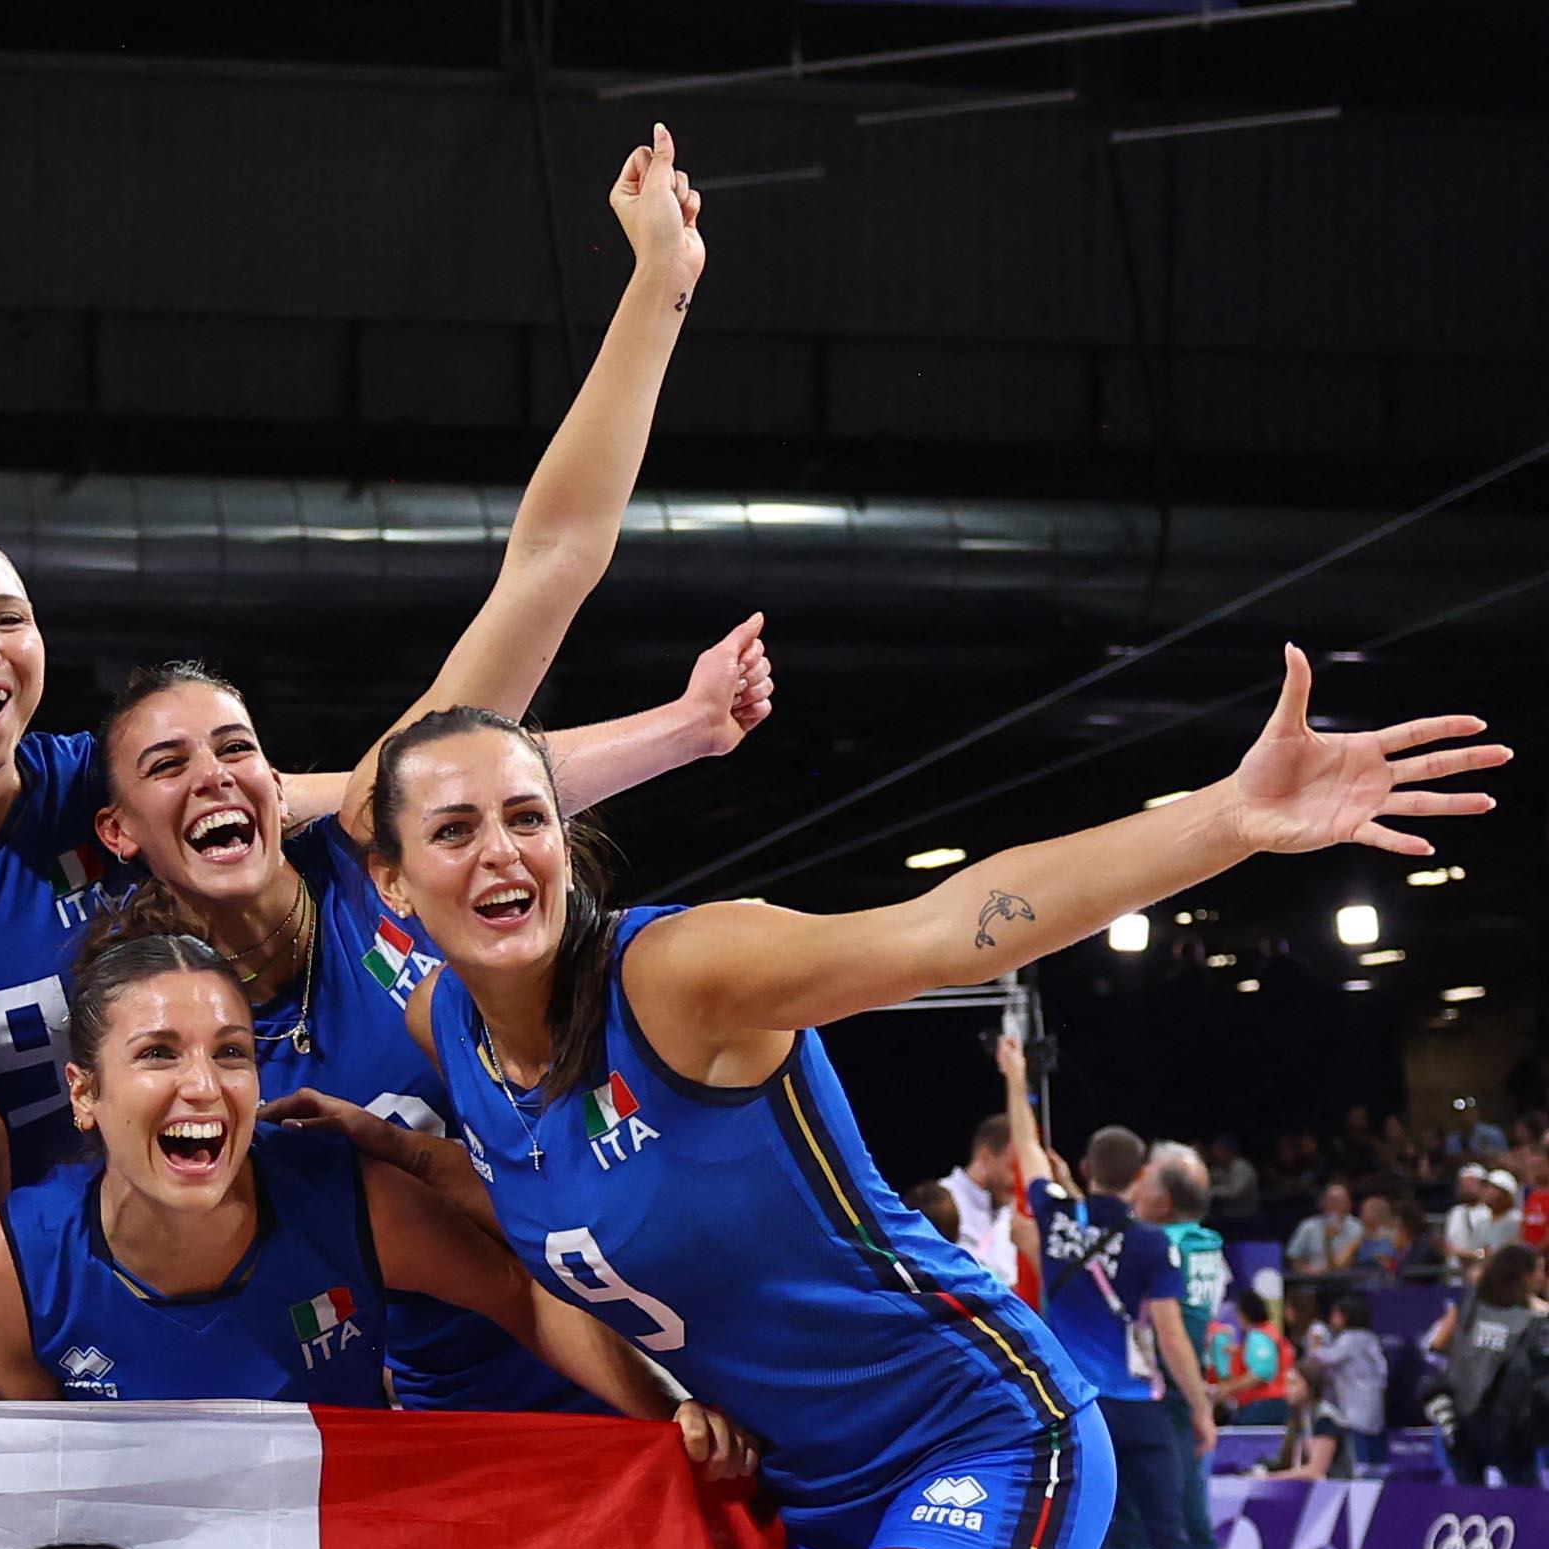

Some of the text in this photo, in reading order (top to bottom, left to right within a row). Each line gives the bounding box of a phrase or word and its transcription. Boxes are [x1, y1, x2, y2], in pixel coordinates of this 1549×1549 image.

[389, 950, 442, 1012] ITA
[590, 1116, 661, 1170] ITA
[545, 1227, 685, 1351] 9
[301, 1319, 362, 1371] ITA
[911, 1504, 983, 1532] errea
